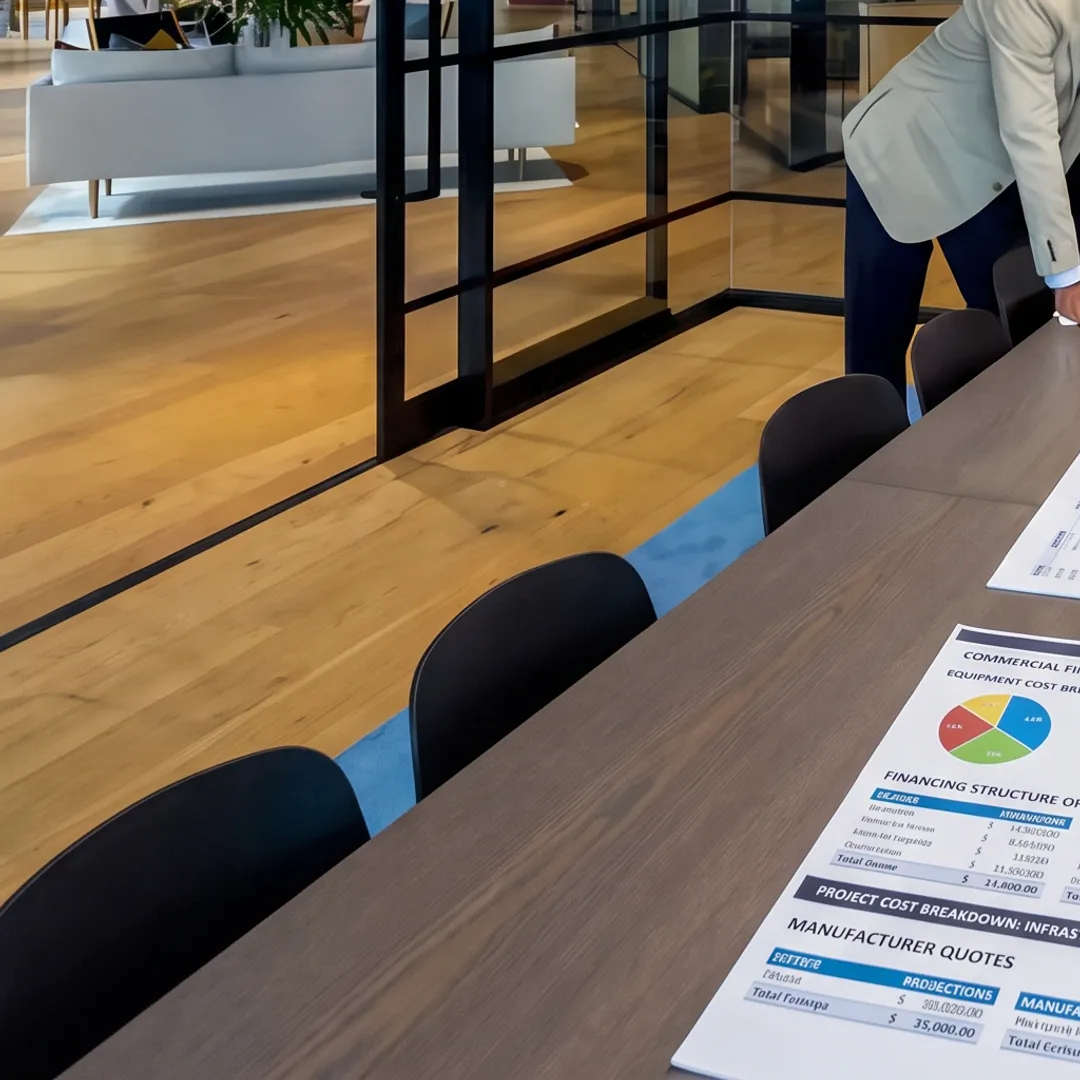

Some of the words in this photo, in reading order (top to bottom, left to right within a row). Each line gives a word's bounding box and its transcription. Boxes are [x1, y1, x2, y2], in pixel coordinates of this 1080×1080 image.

[963, 651, 1061, 672] COMMERCIAL
[947, 669, 1023, 686] EQUIPMENT
[1024, 679, 1058, 691] COST
[884, 770, 968, 793] FINANCING
[970, 783, 1060, 805] STRUCTURE
[837, 854, 863, 865] Total
[815, 884, 880, 906] PROJECT
[879, 895, 919, 913] COST
[919, 903, 1022, 931] BREAKDOWN:
[787, 916, 937, 956] MANUFACTURER
[940, 944, 1016, 970] QUOTES
[752, 987, 783, 1001] Total
[913, 1018, 976, 1039] 35,000.00
[1008, 1034, 1042, 1051] Total
